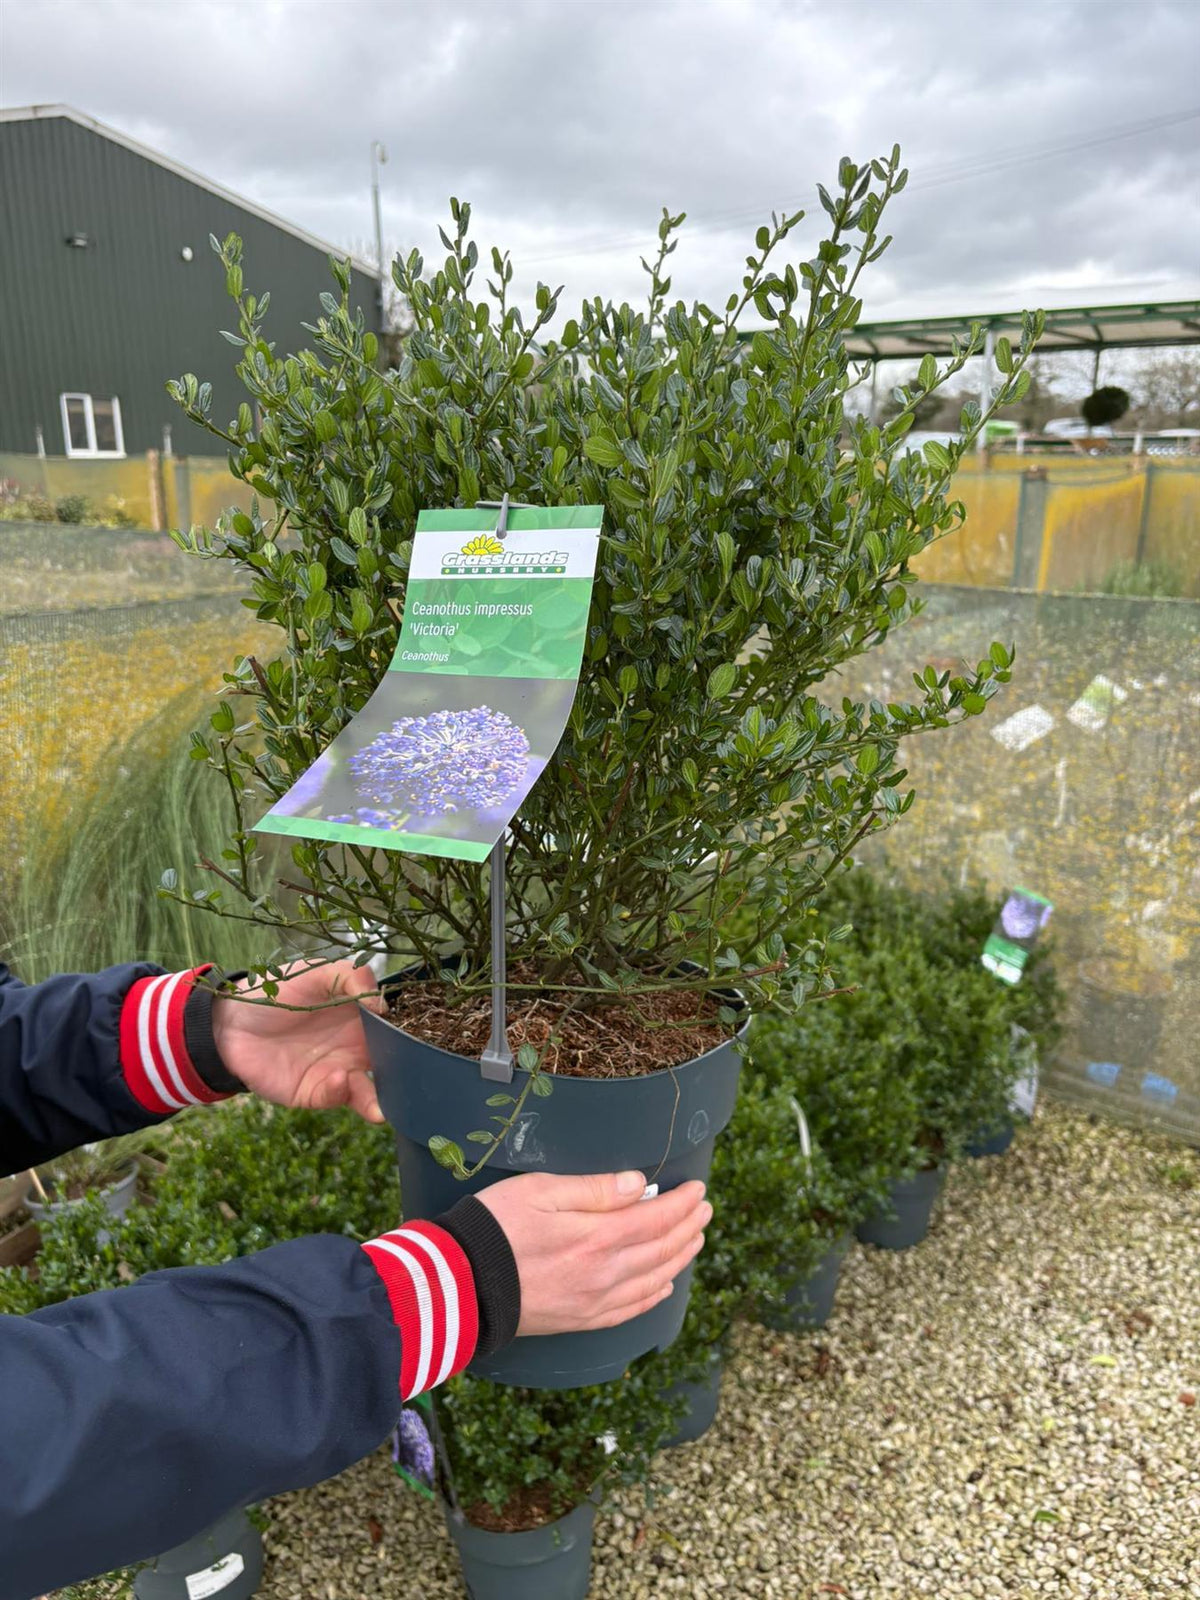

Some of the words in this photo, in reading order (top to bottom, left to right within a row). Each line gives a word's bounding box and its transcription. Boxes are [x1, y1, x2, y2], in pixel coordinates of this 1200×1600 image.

[441, 550, 570, 566] Grasslands
[457, 566, 549, 575] NURSERY
[412, 601, 471, 616] Ceanothus
[474, 601, 533, 618] impressus
[410, 622, 460, 636] 'Victoria'
[401, 650, 449, 662] Ceanothus
